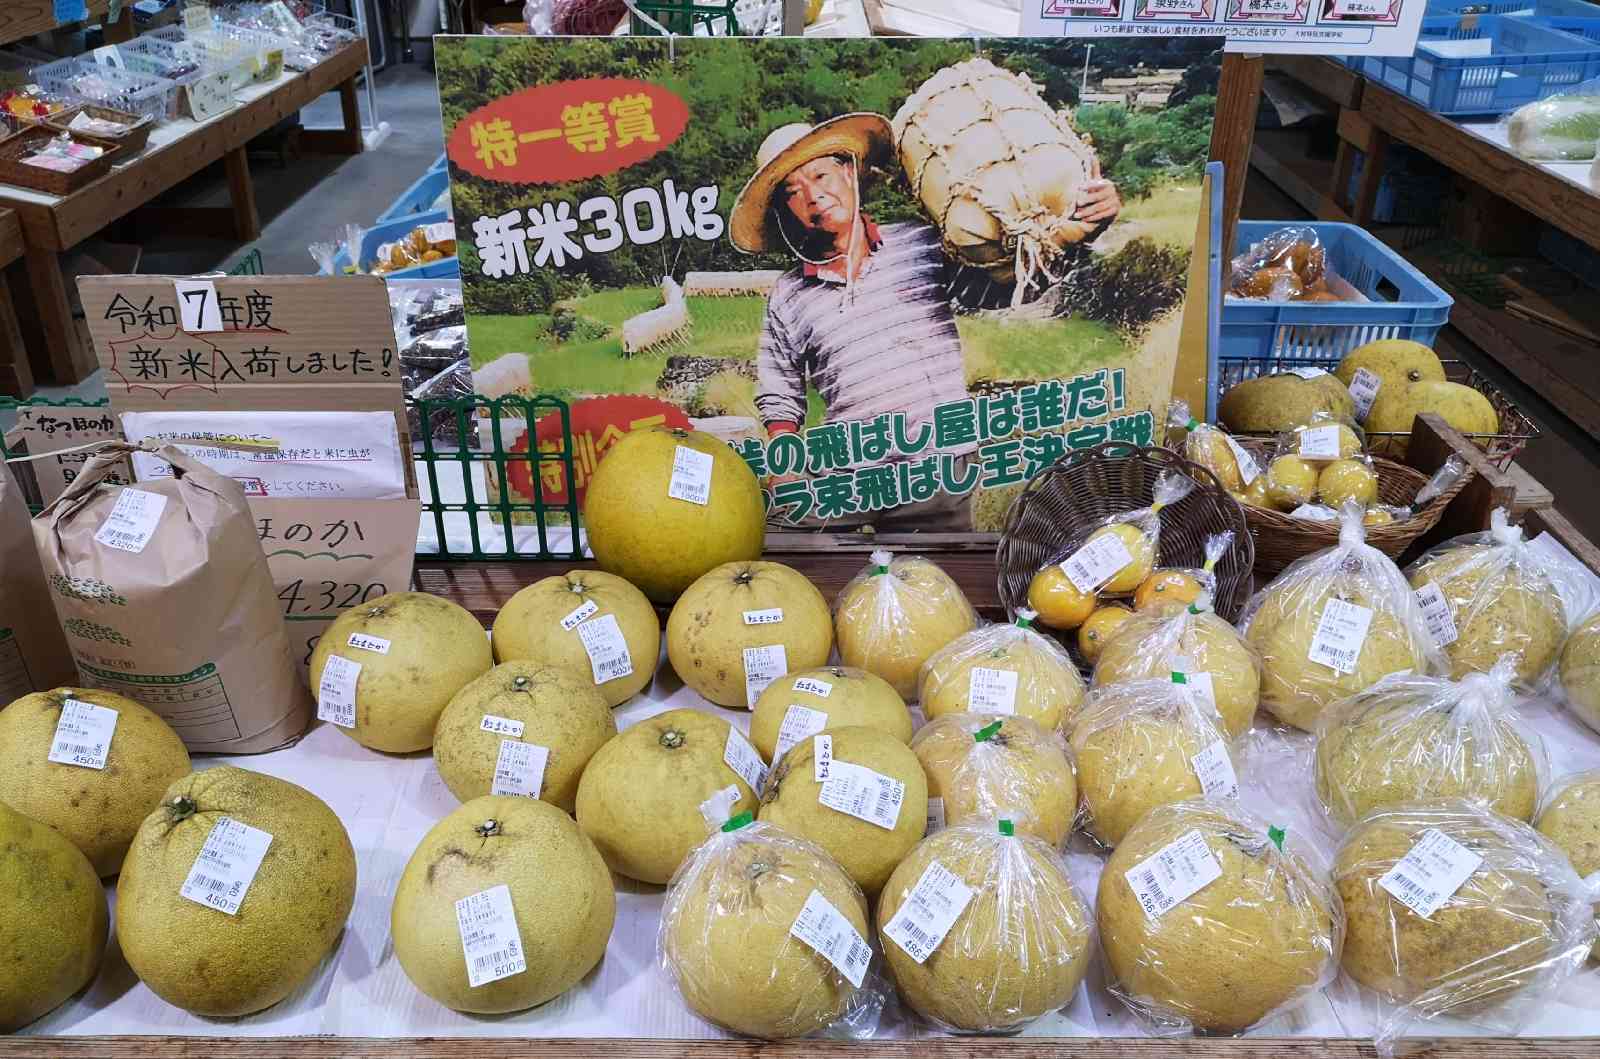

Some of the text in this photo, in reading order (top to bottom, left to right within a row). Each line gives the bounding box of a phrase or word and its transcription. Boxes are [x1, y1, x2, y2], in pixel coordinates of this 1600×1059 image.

[470, 92, 661, 170] 特一等賞
[472, 178, 725, 280] 新米30kg
[103, 288, 276, 334] 令和7年度
[762, 409, 1154, 526] ラ束飛ばし王決定戦
